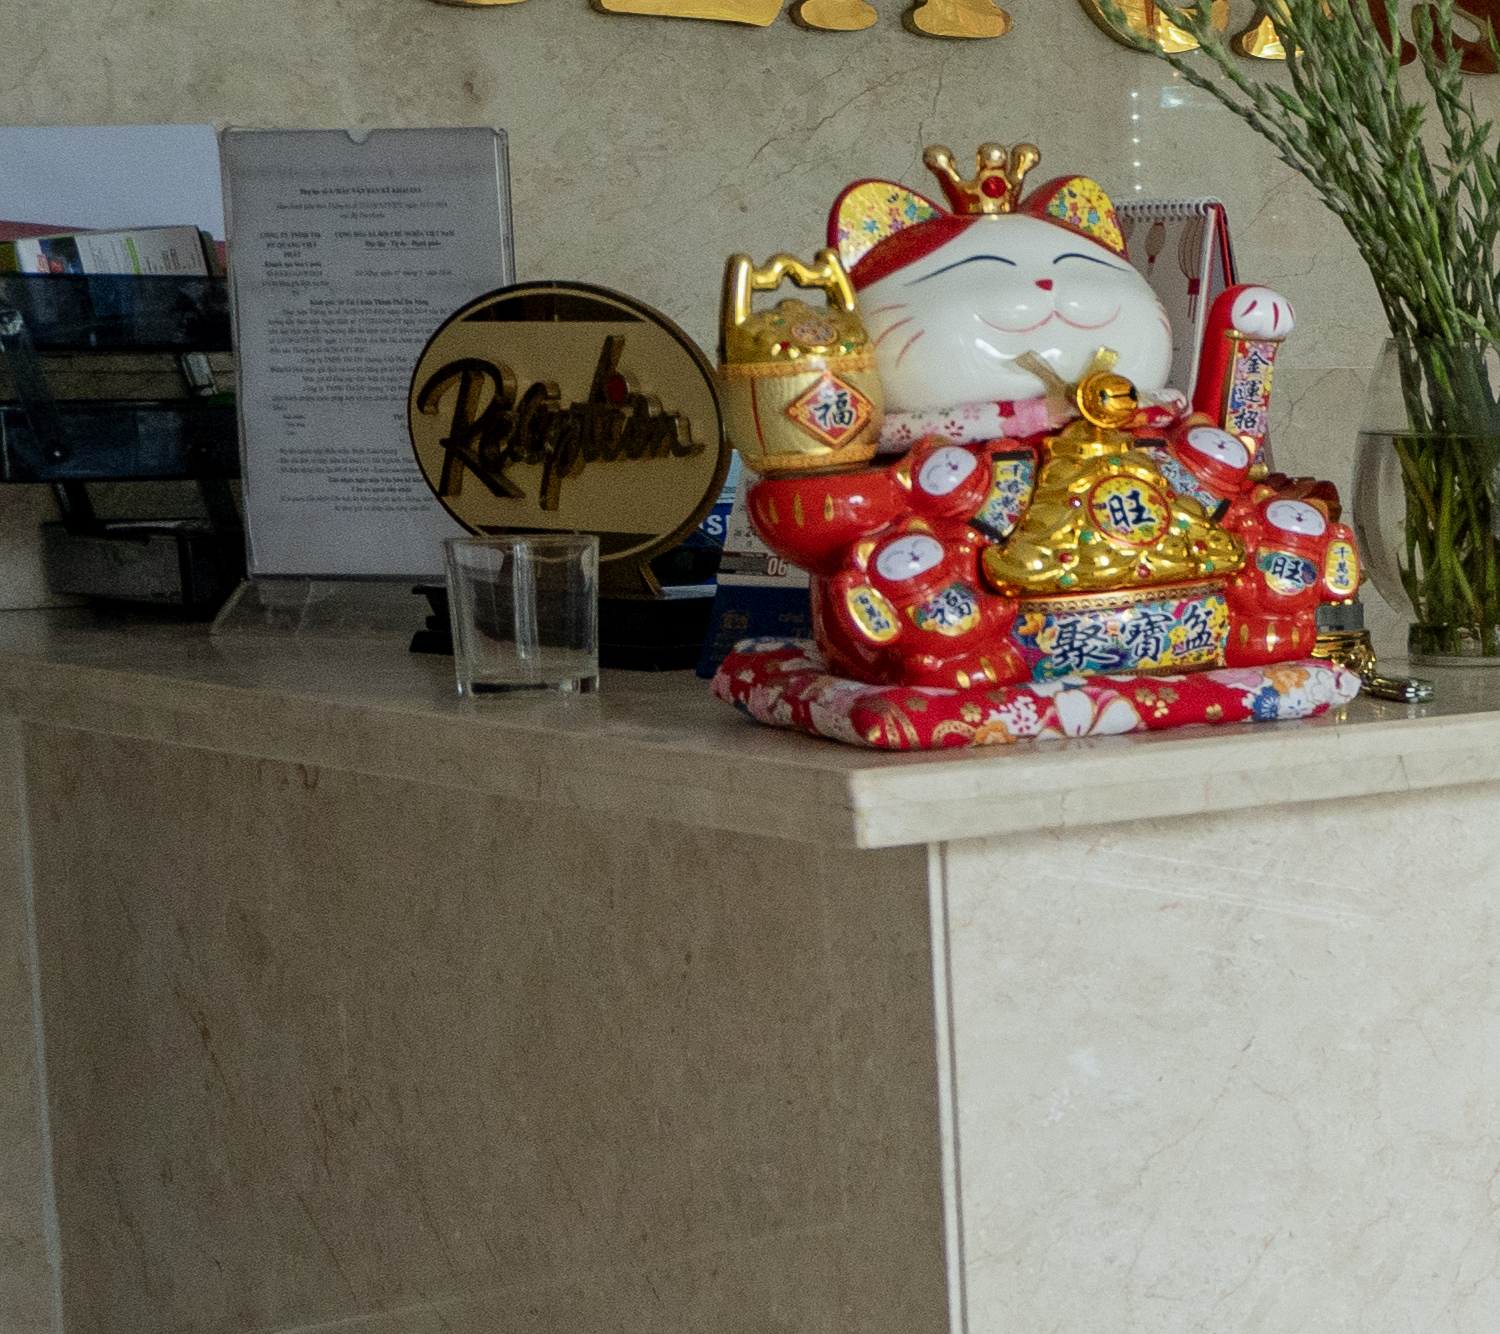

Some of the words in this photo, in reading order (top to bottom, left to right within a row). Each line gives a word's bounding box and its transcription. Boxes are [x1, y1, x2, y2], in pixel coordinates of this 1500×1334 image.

[415, 334, 706, 511] Reception
[812, 393, 855, 429] 福
[1107, 489, 1156, 528] 旺
[1271, 556, 1303, 585] 旺
